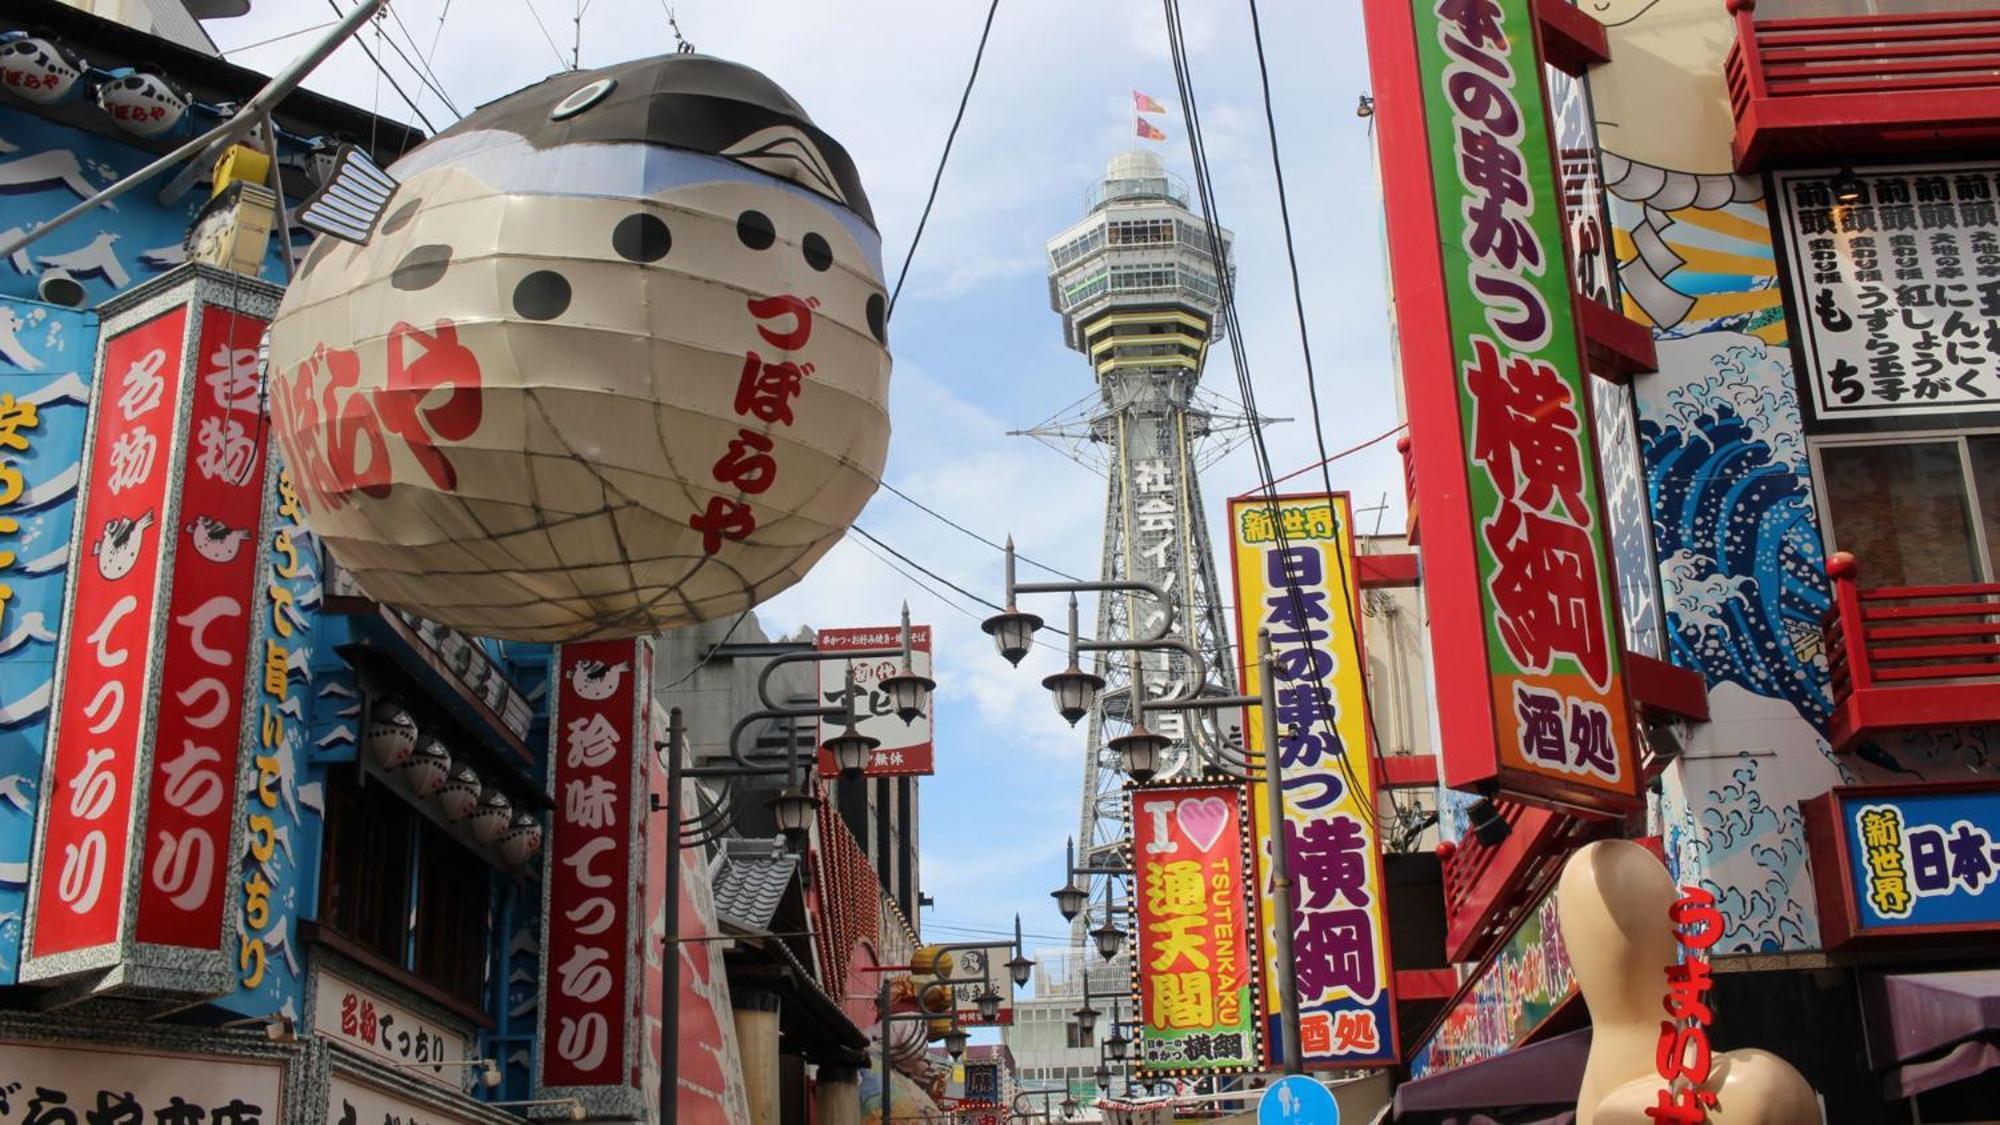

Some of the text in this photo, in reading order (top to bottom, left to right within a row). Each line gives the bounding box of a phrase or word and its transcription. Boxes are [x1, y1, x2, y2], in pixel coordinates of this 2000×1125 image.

[1815, 288, 1865, 404] もち
[1857, 286, 1910, 401] うずら玉子
[1893, 284, 1953, 400] 紅しょうが
[1934, 284, 1987, 398] にんにく
[691, 293, 822, 556] づぼらや
[1241, 506, 1338, 543] 新世界
[1464, 339, 1611, 690] 横綱
[58, 595, 137, 914] てっちり
[153, 596, 241, 911] てっちり
[1519, 692, 1617, 776] 酒処
[1143, 800, 1179, 854] I
[1860, 808, 1912, 914] 新世界
[557, 713, 621, 1072] 珍味てっちり
[1146, 859, 1214, 1030] 通天閣
[1211, 856, 1241, 1026] TSUTENKAKU
[341, 993, 444, 1072] 名物てっちり
